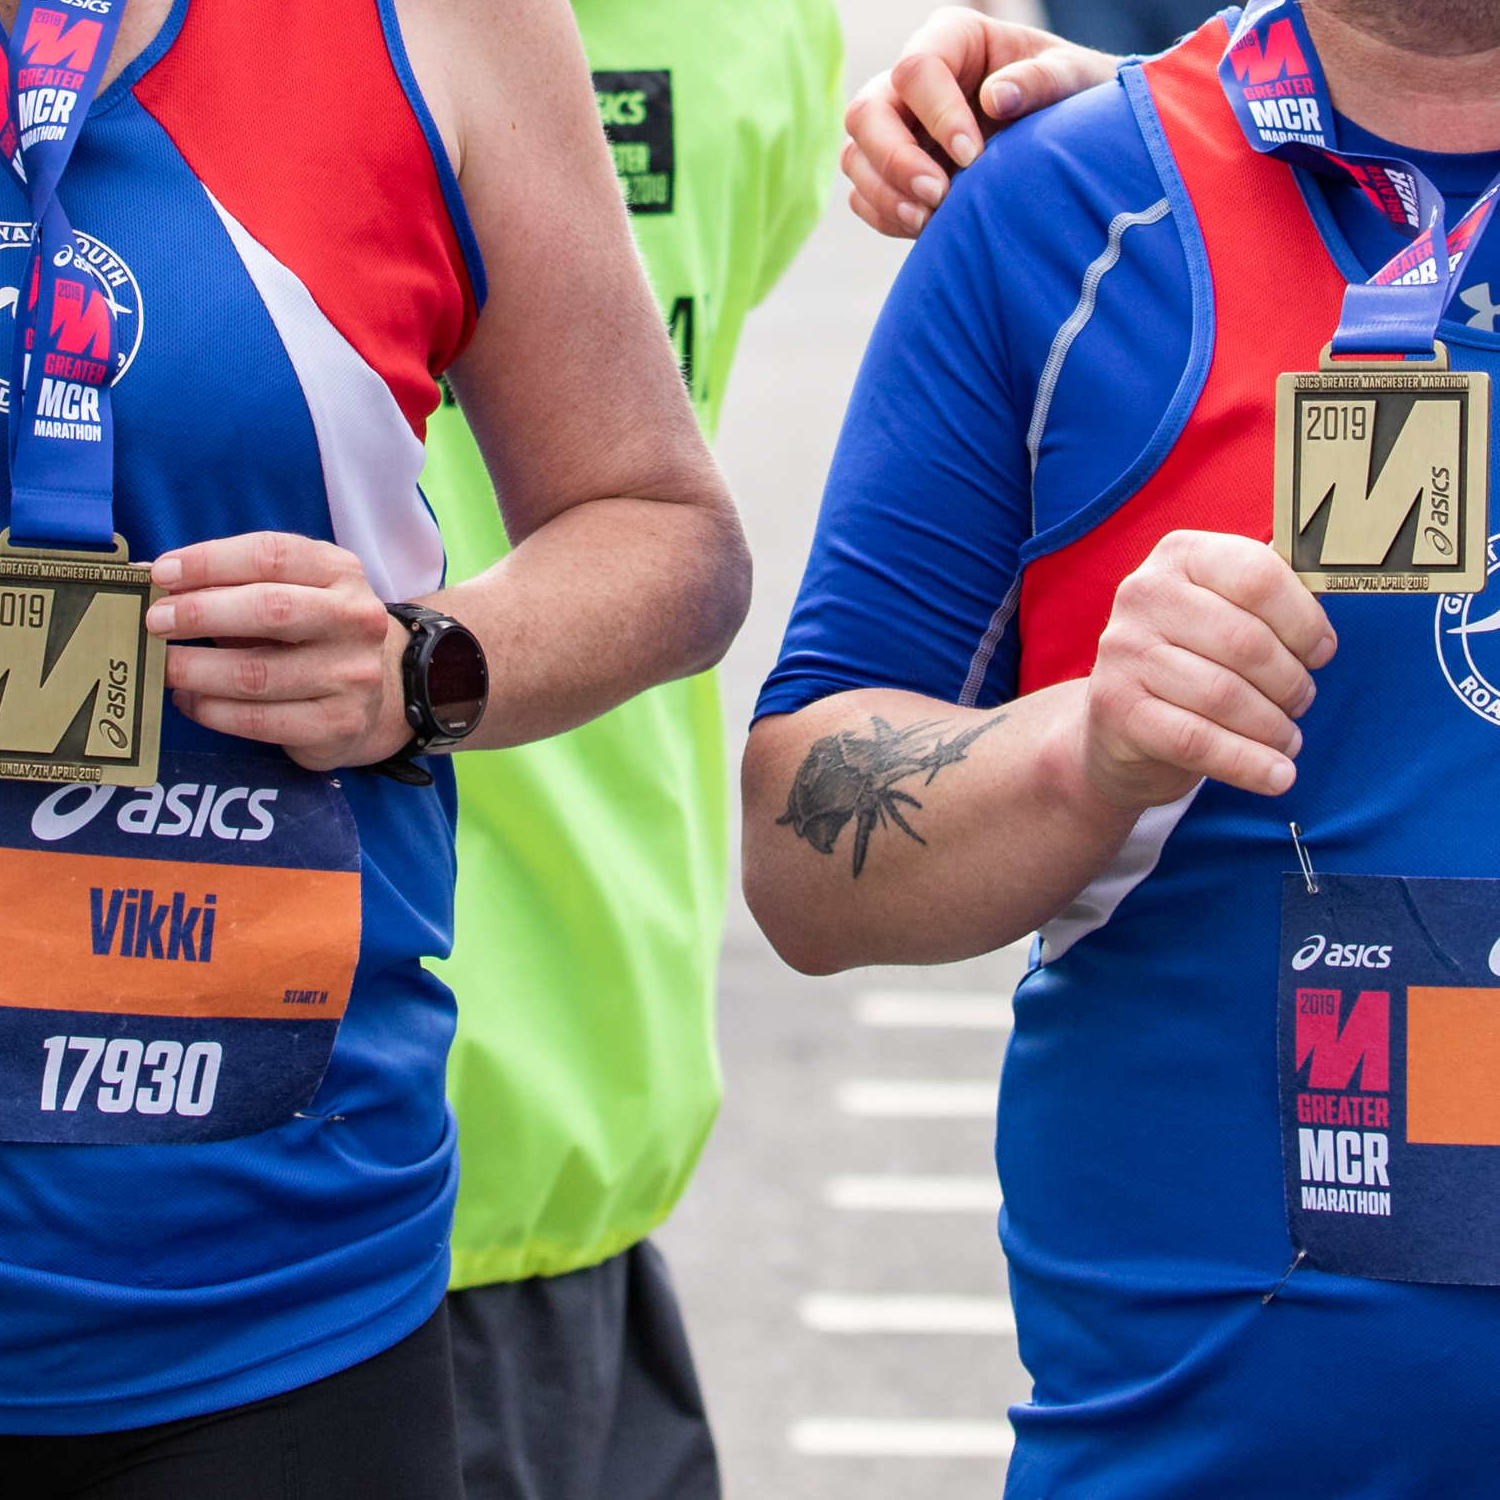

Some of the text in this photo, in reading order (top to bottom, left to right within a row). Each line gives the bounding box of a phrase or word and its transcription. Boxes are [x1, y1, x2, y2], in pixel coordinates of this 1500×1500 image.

[34, 11, 62, 27] 2019
[18, 67, 86, 91] GREATER
[1242, 76, 1316, 101] GREATER
[18, 88, 78, 132] MCR
[1248, 97, 1323, 132] MCR
[1366, 164, 1407, 225] GREATER
[1383, 167, 1420, 229] MCR
[1375, 240, 1435, 286] GREATER
[57, 281, 82, 301] 2019
[44, 352, 107, 385] GREATER
[1293, 376, 1469, 389] ASICS GREATER MANCHESTER MARATHON
[37, 378, 100, 422] MCR
[34, 420, 102, 442] MARATHON
[1306, 406, 1367, 441] 2019
[0, 562, 40, 577] GREATER
[41, 564, 100, 581] MANCHESTER
[102, 567, 151, 584] MARATHON
[1325, 576, 1429, 590] SUNDAY 7TH APRIL 2019
[32, 764, 50, 779] 7TH
[50, 765, 77, 780] APRIL
[78, 767, 102, 781] 2019
[89, 886, 217, 964] Vikki
[283, 988, 328, 1006] START H
[1300, 993, 1336, 1016] 2019
[40, 1034, 222, 1117] 17930
[1297, 1092, 1390, 1128] GREATER
[1298, 1128, 1390, 1188] MCR
[1300, 1185, 1392, 1217] MARATHON
